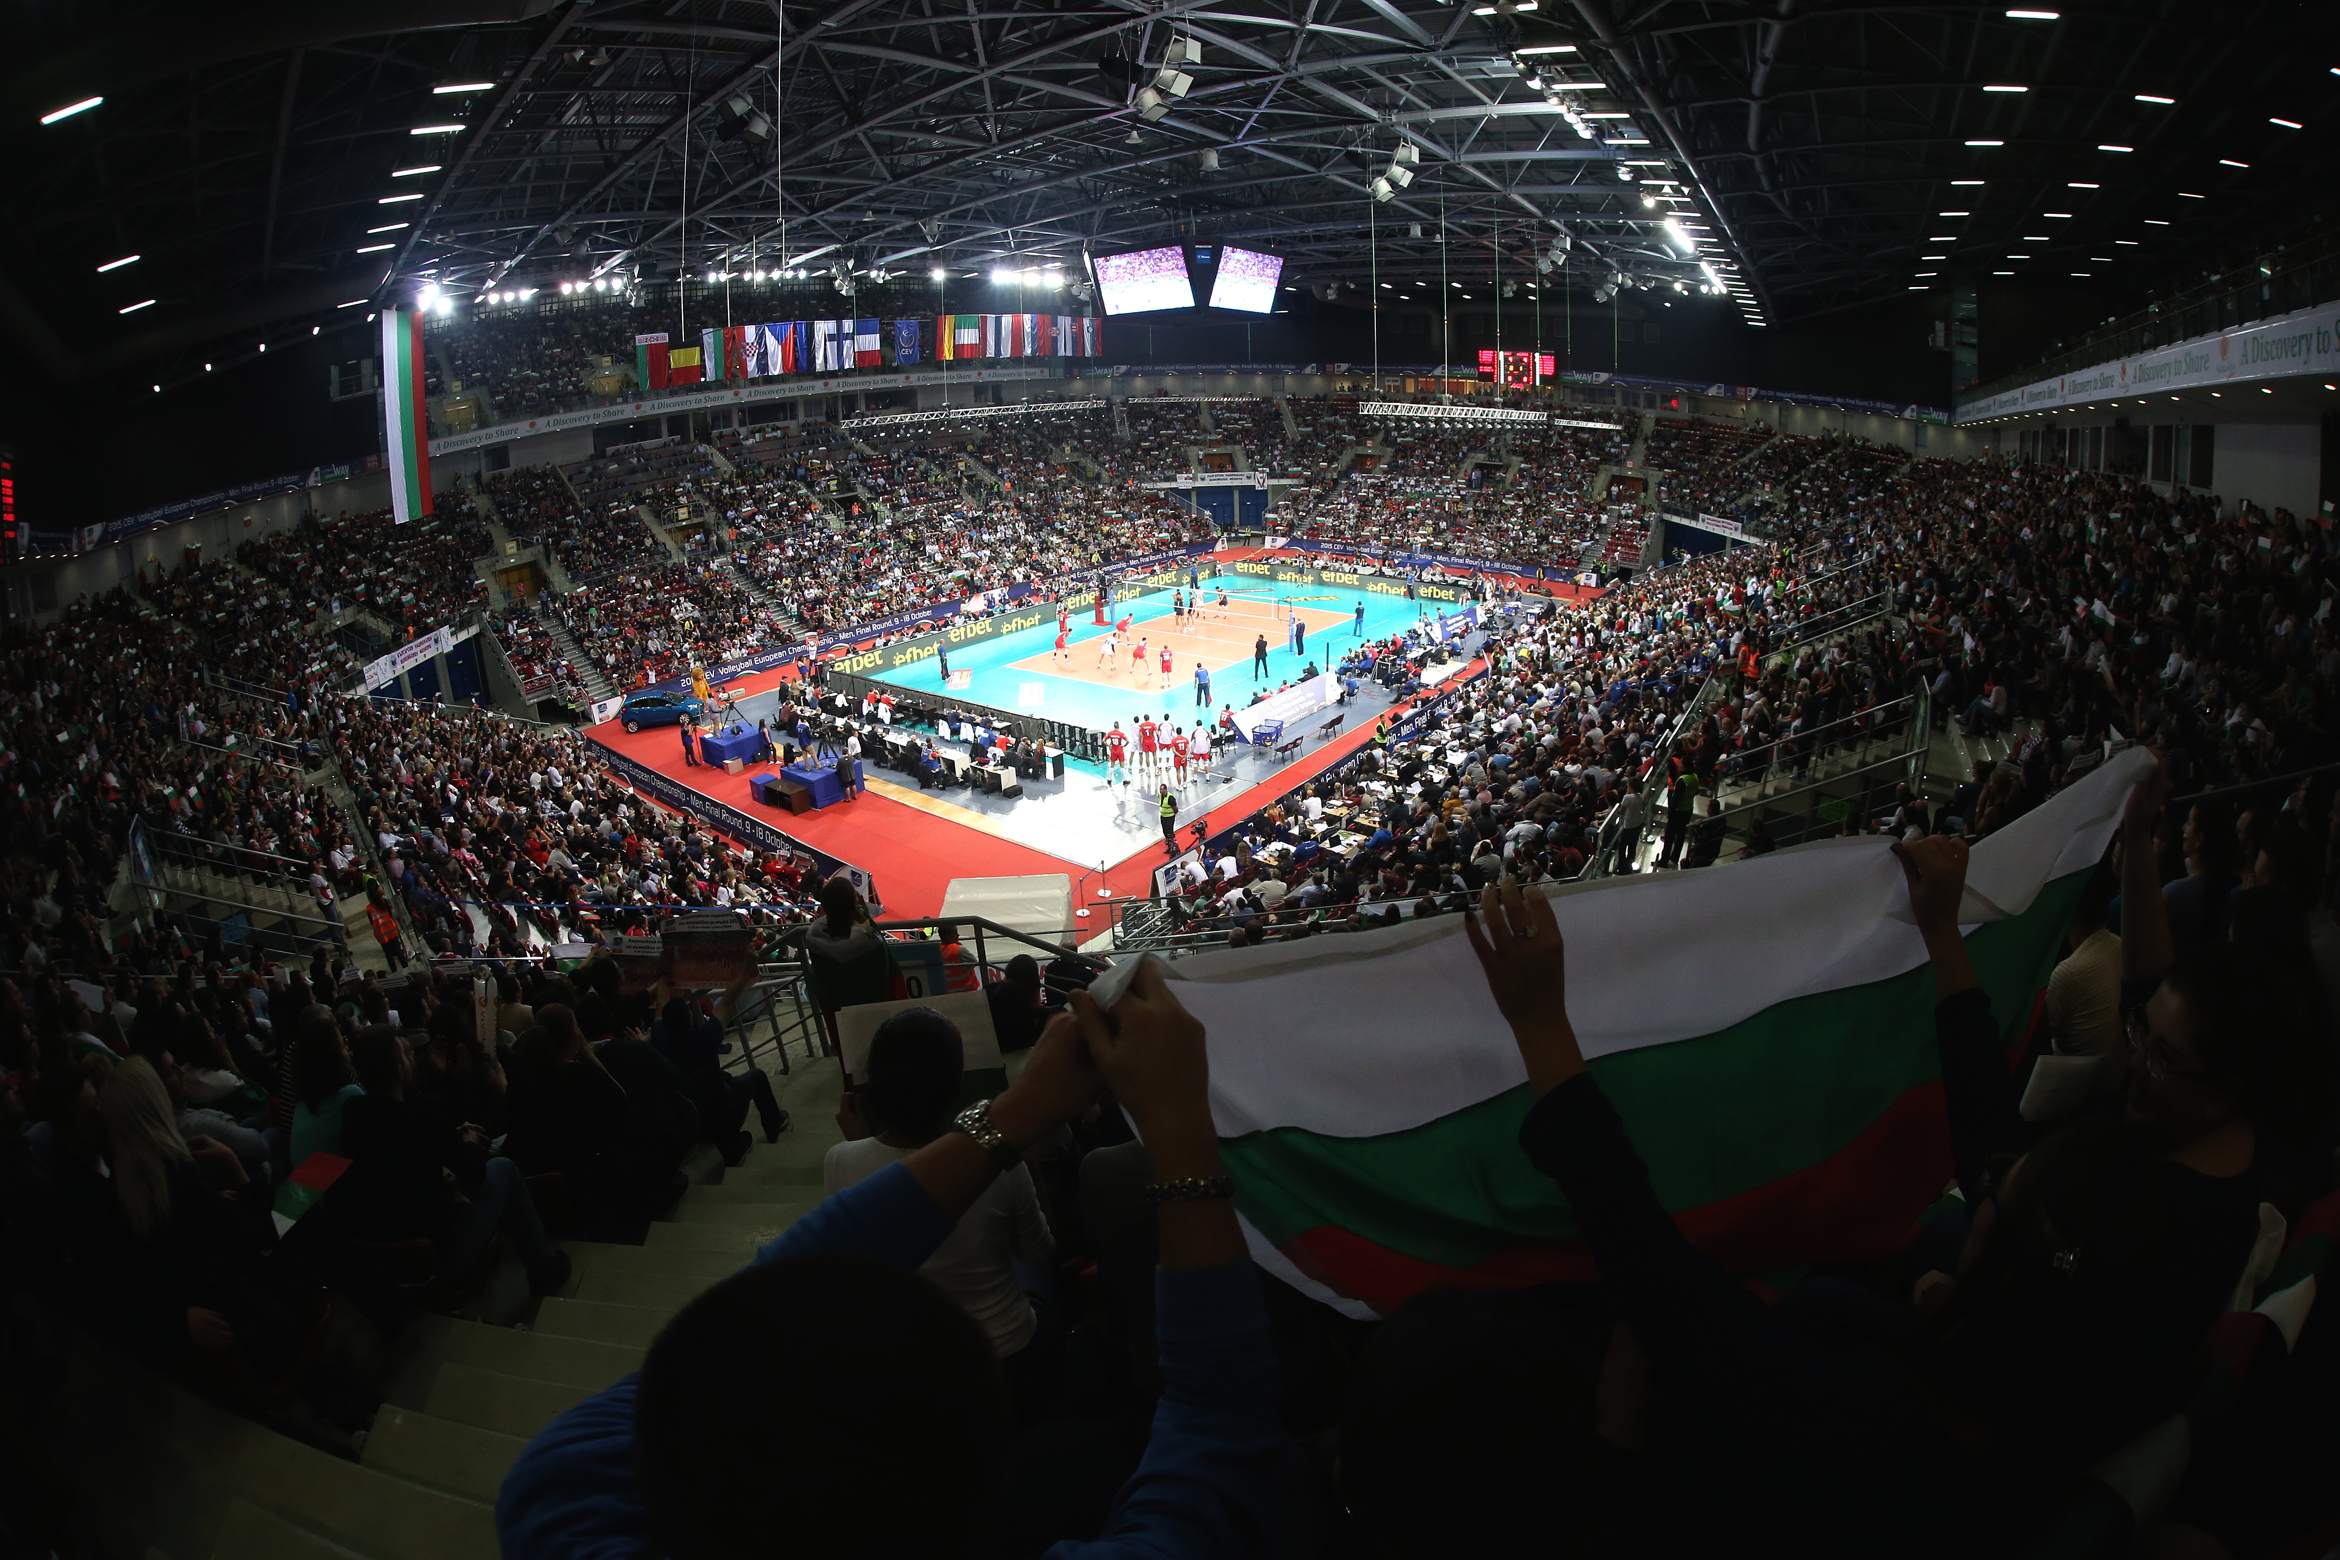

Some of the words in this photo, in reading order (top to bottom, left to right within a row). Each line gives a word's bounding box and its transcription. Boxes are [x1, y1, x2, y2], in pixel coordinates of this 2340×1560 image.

[2251, 332, 2313, 365] Discovery
[2316, 327, 2331, 355] to
[2183, 352, 2210, 375] Share
[753, 387, 787, 397] Discovery
[797, 383, 816, 392] Share
[657, 398, 693, 410] Discovery
[704, 394, 725, 404] Share
[545, 420, 551, 428] A
[553, 415, 592, 427] Discovery
[593, 412, 601, 420] to
[602, 408, 625, 418] Share
[435, 443, 442, 452] A
[443, 435, 482, 450] Discovery
[485, 432, 494, 440] to
[494, 427, 519, 439] Share
[1451, 556, 1464, 564] Final
[1502, 563, 1523, 571] October
[1418, 585, 1456, 601] efbet
[718, 659, 753, 676] Volleyball
[754, 650, 787, 665] European
[839, 631, 854, 641] Men,
[856, 627, 871, 636] Final
[872, 621, 893, 631] Round,
[911, 608, 932, 621] October
[609, 752, 628, 772] Volleyball
[629, 763, 650, 784] European
[651, 775, 686, 803] Championship
[690, 794, 705, 812] Men,
[705, 802, 720, 818] Final
[721, 810, 744, 832] Round,
[745, 821, 751, 833] 9
[755, 825, 764, 839] 18
[765, 830, 793, 854] October
